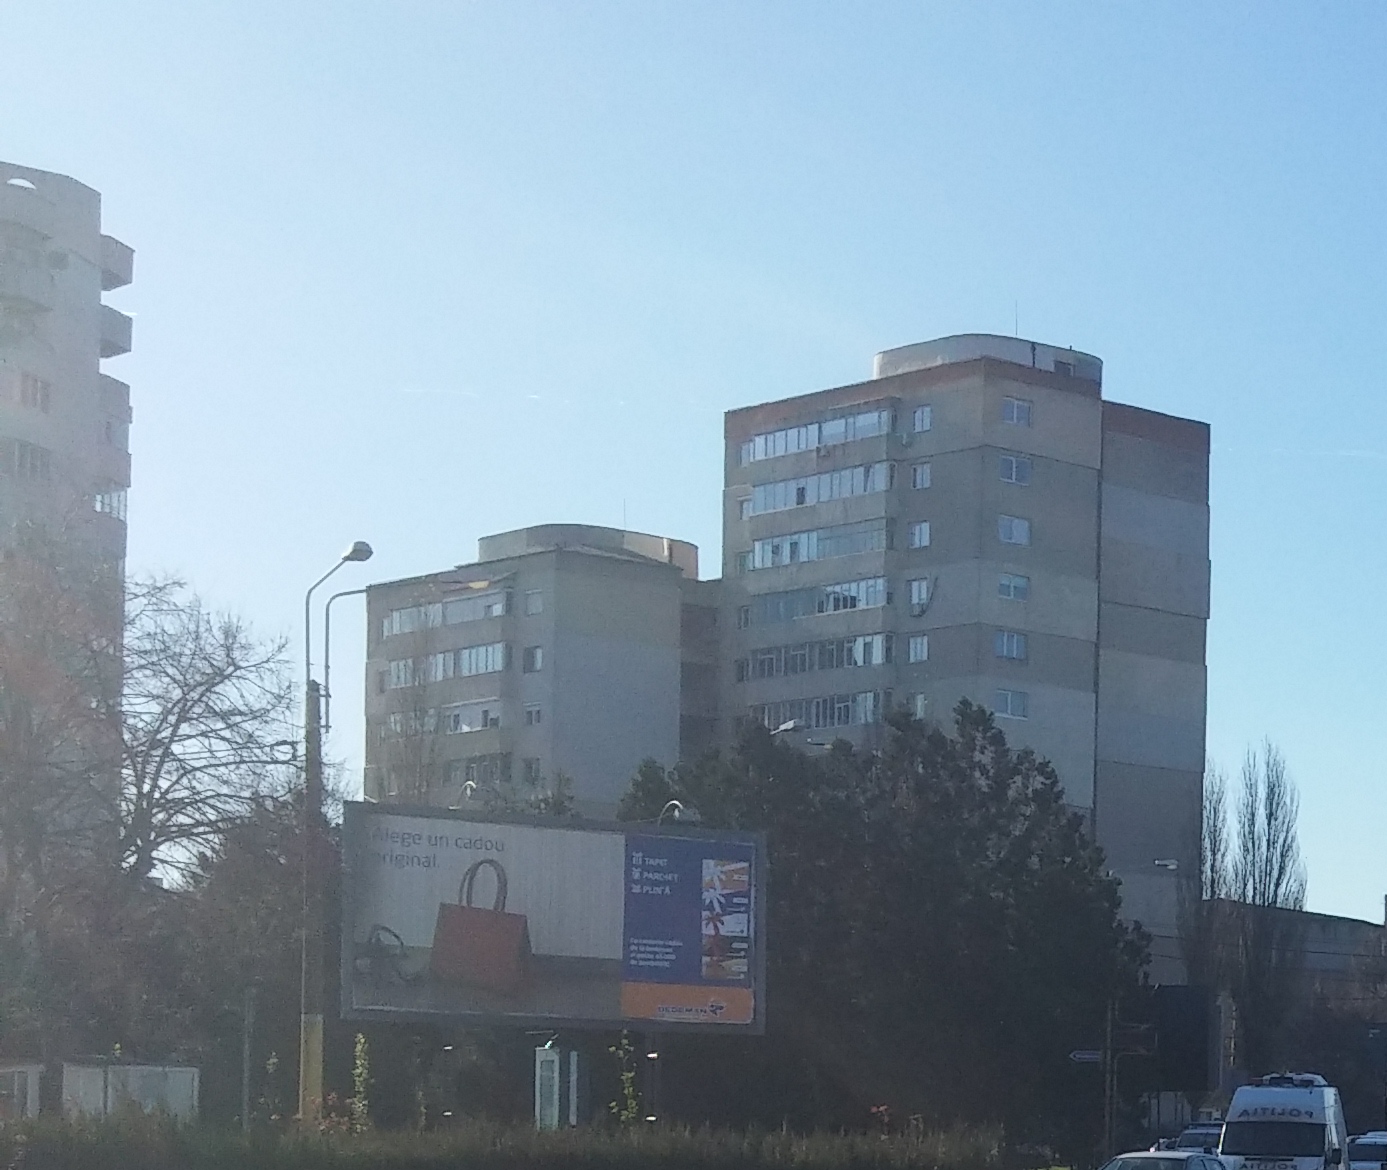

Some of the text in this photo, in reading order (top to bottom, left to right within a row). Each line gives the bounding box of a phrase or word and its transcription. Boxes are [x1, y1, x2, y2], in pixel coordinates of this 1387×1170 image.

[427, 834, 449, 847] un
[454, 836, 506, 852] cadou
[373, 850, 440, 868] riginal.
